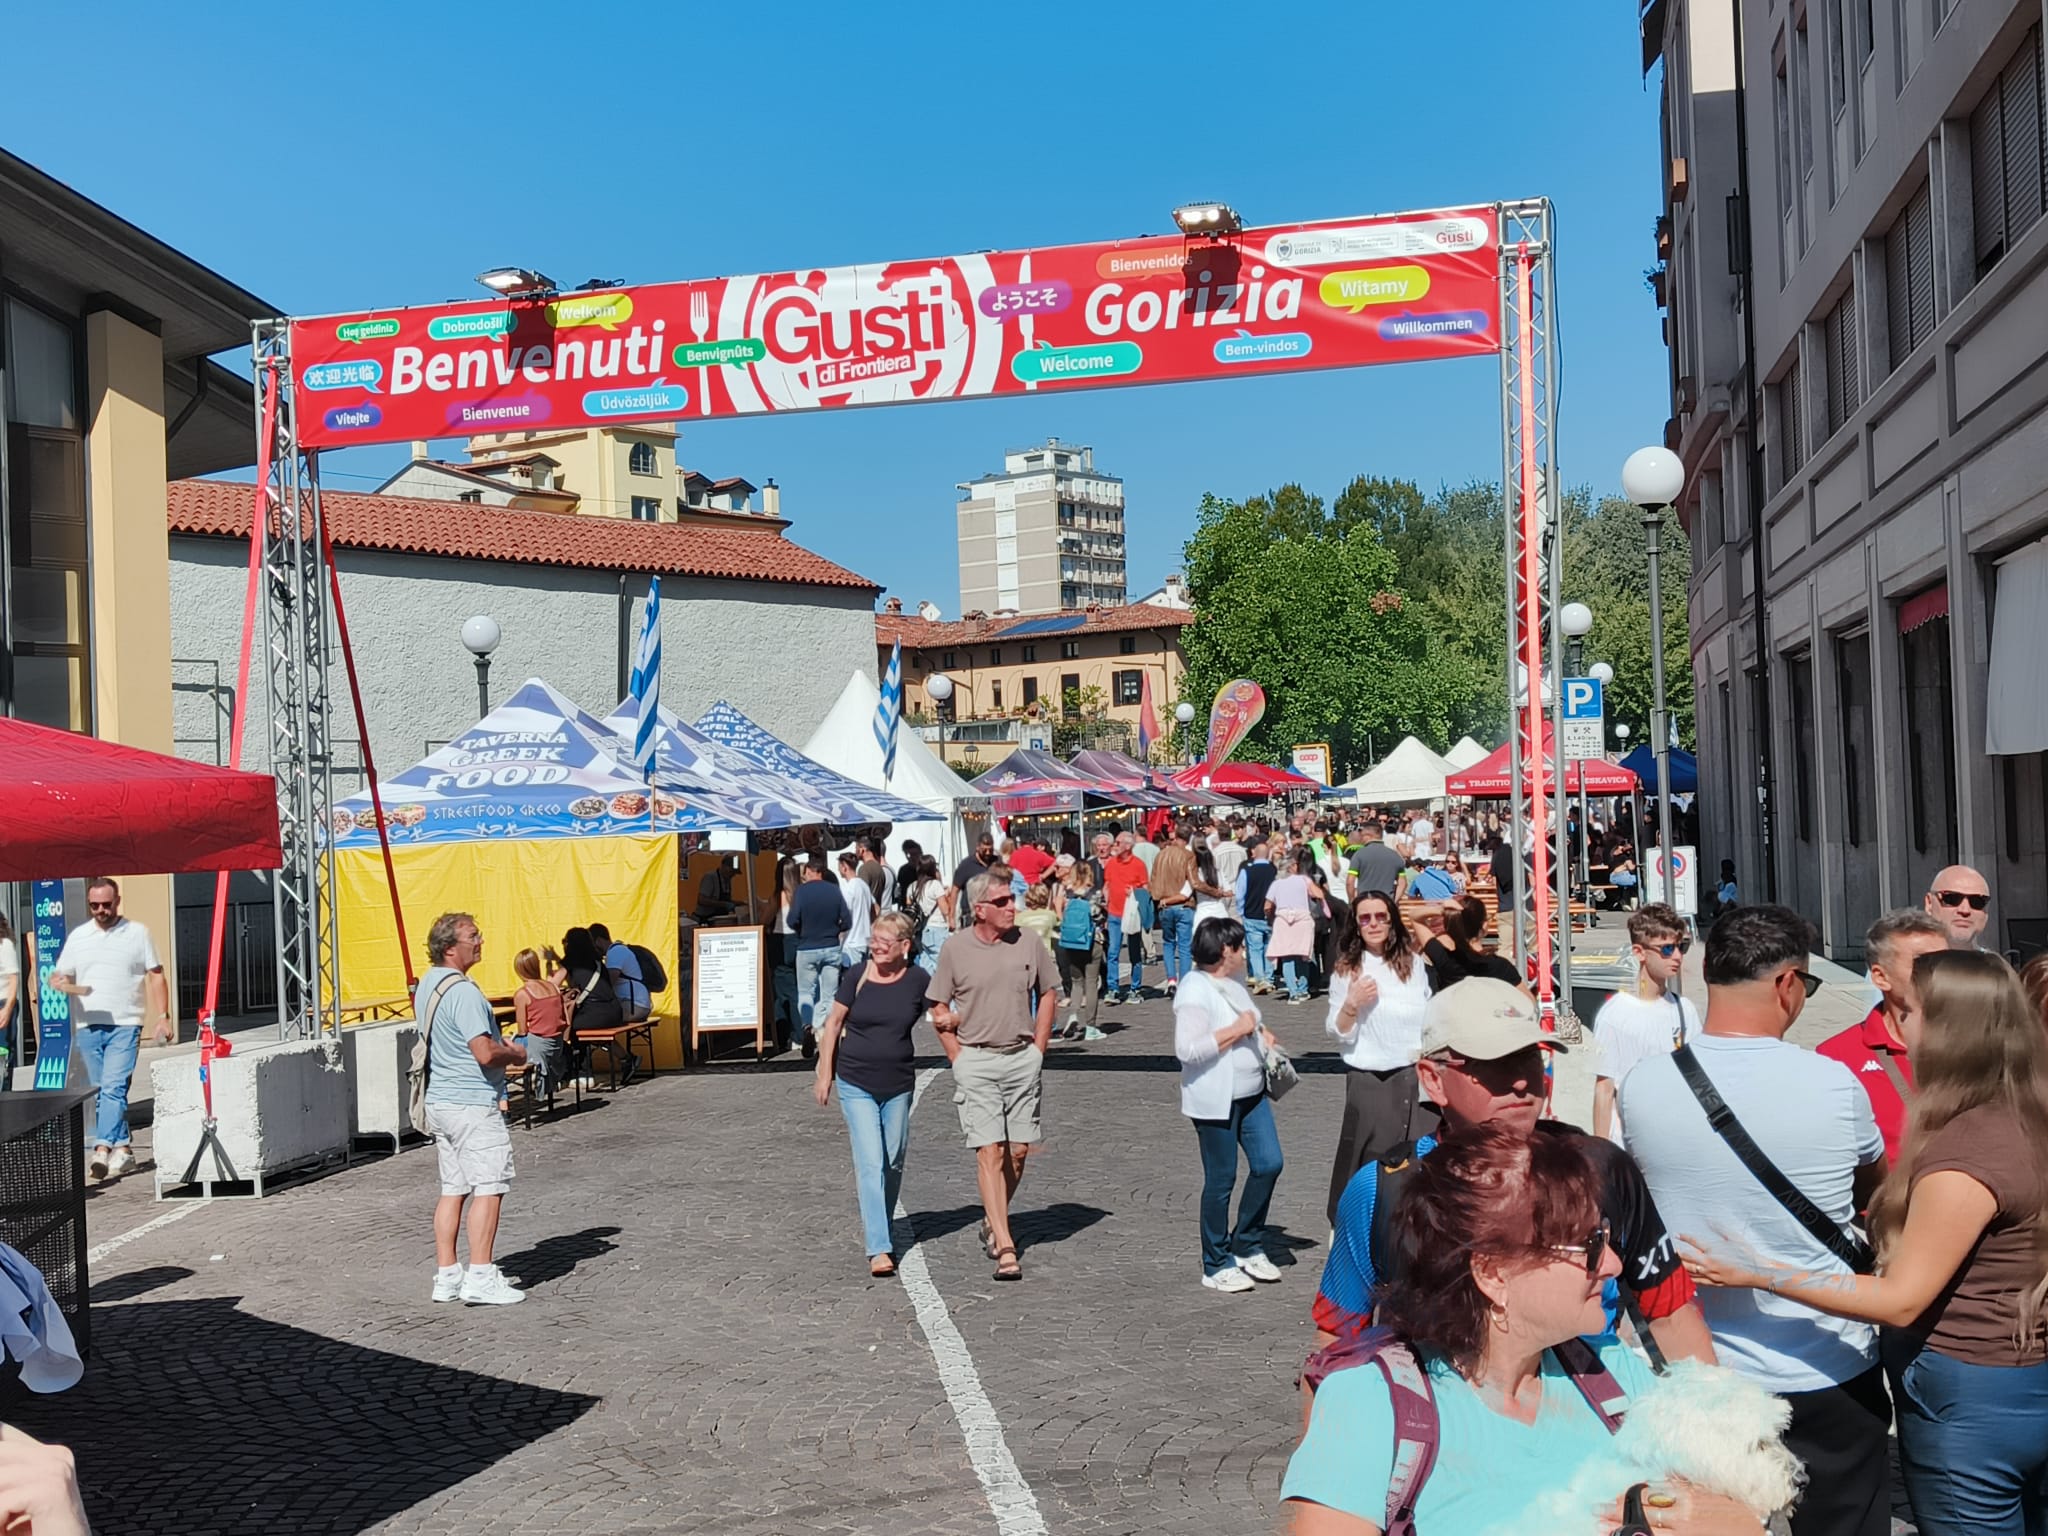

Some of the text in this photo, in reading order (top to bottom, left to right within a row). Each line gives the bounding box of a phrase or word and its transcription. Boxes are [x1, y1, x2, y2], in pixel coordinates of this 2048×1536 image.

[1436, 227, 1474, 245] Gusti
[1110, 252, 1193, 273] Bienvenidos
[1340, 278, 1408, 299] Witamy
[991, 287, 1058, 311] ようこそ
[1085, 266, 1303, 336] Gorizia
[560, 303, 617, 321] Welkom
[442, 314, 503, 334] Dobrodošli
[762, 290, 946, 362] Gusti
[1393, 316, 1473, 335] Willkommen
[686, 343, 754, 363] Benvignûts
[1225, 337, 1299, 355] Bem-vindos
[390, 319, 665, 396] Benvenuti
[1039, 352, 1114, 374] Welcome
[308, 364, 375, 386] 欢迎光临
[820, 352, 911, 385] di Frontiera
[462, 403, 530, 421] Bienvenue
[600, 391, 670, 413] Üdvözöljük
[335, 412, 371, 427] Vítejte
[1567, 682, 1594, 716] P
[460, 732, 570, 751] TAVERNA
[449, 747, 569, 767] GREEK
[424, 765, 570, 793] FOOD
[1568, 775, 1628, 786] PLESKAVICA
[433, 803, 561, 820] STREETFOOD GRECO
[38, 938, 61, 949] Border
[39, 952, 53, 962] less
